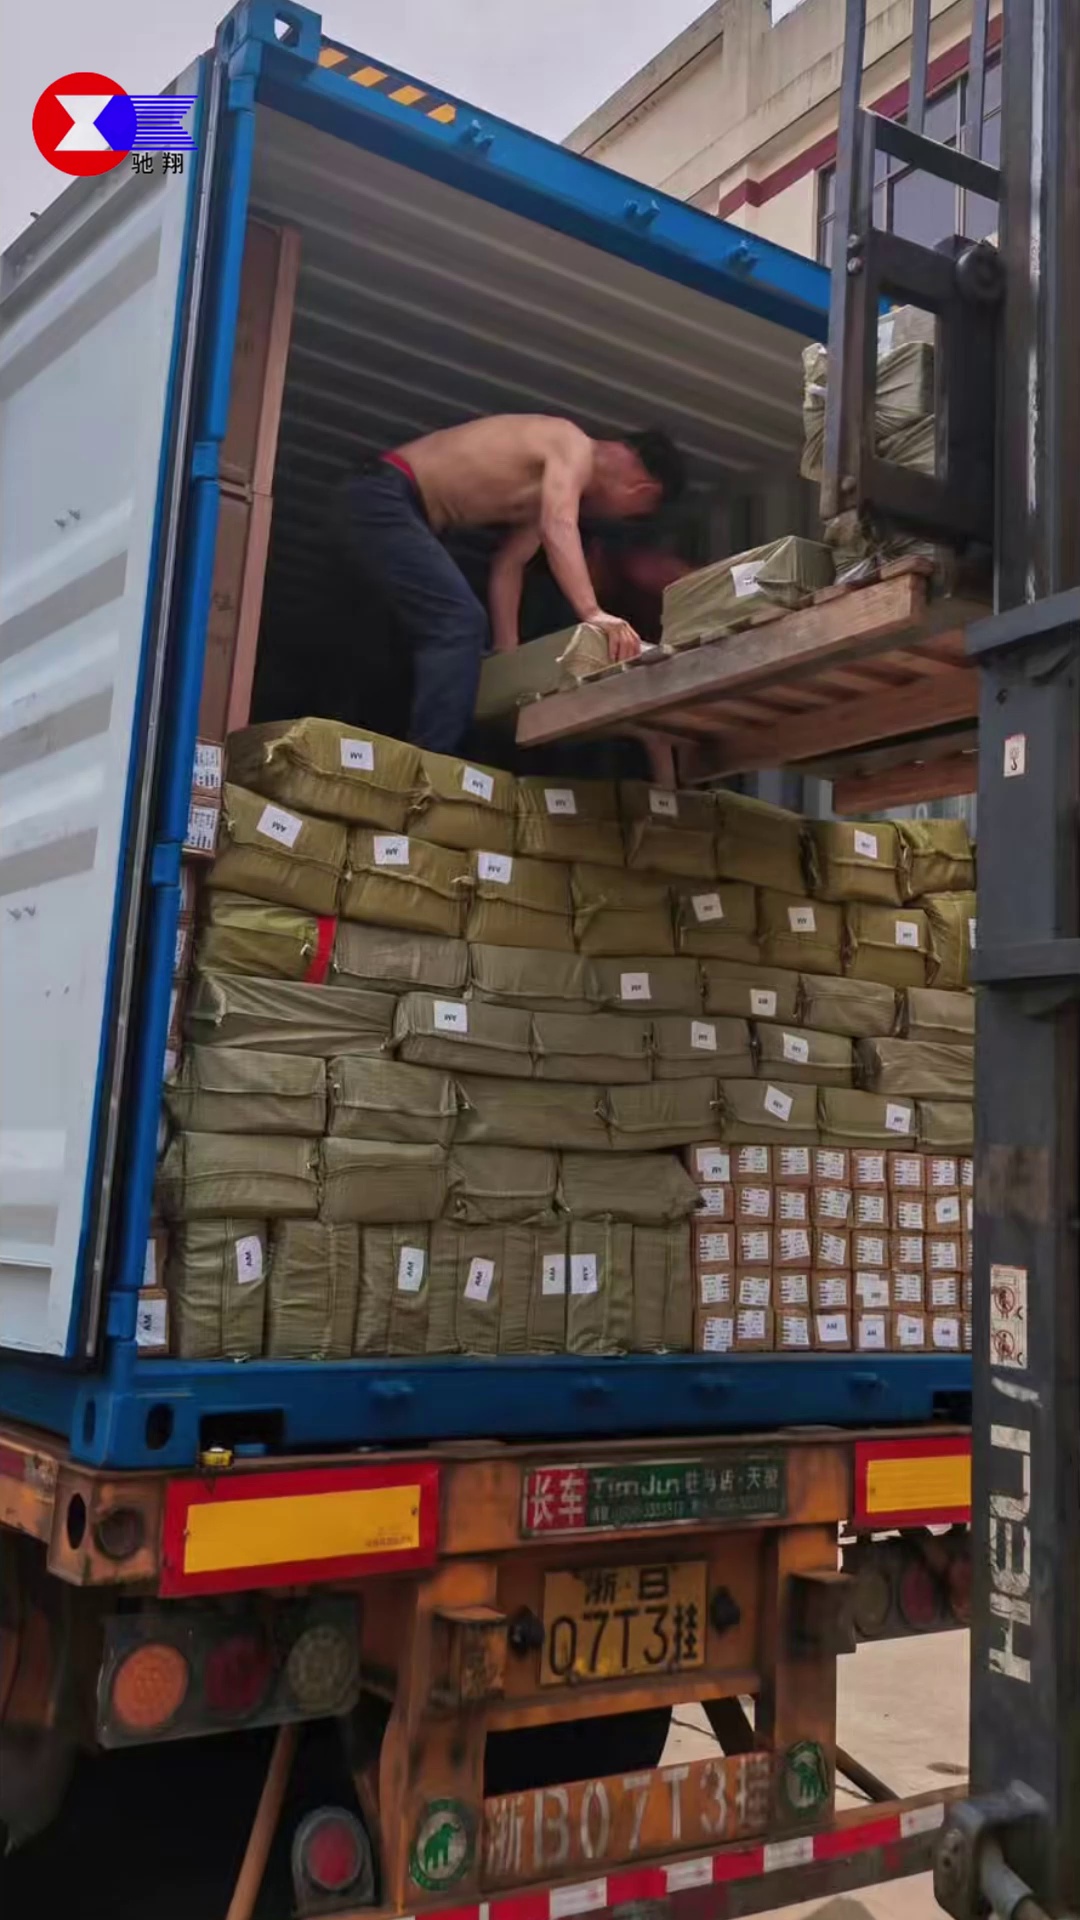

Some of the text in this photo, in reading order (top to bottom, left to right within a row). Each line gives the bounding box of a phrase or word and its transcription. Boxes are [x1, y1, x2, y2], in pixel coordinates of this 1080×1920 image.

[244, 1251, 253, 1267] AM
[406, 1261, 415, 1278] AM
[474, 1271, 483, 1287] AM
[142, 1314, 153, 1332] AM
[988, 1424, 1031, 1683] HELI
